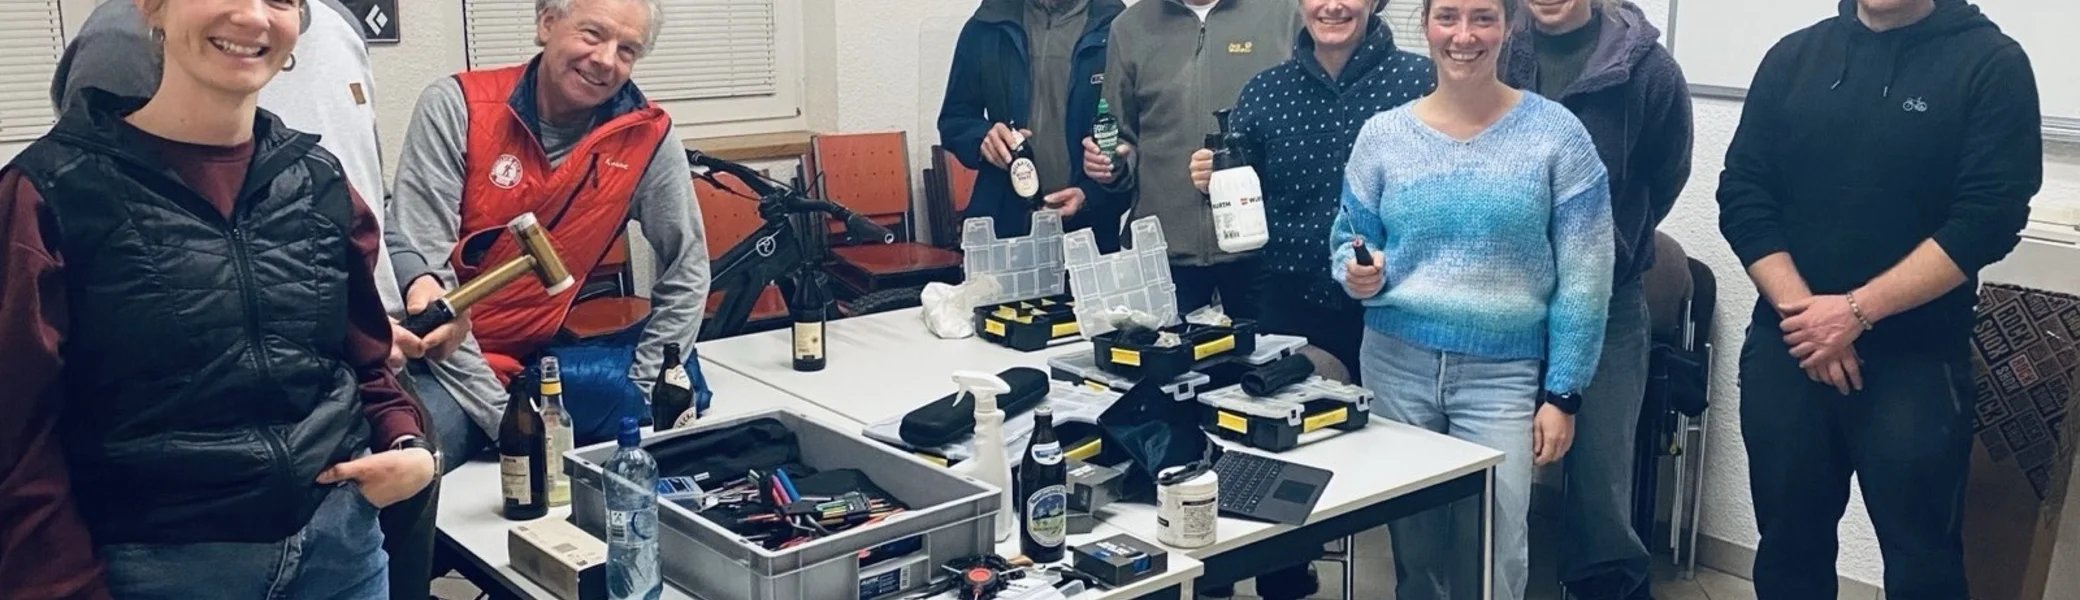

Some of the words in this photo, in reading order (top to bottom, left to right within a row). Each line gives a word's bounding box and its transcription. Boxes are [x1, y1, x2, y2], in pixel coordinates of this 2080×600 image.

[1974, 319, 2009, 360] SHOX
[1997, 306, 2033, 348] ROCK
[1995, 366, 2019, 393] SHOX
[2012, 357, 2035, 385] ROCK
